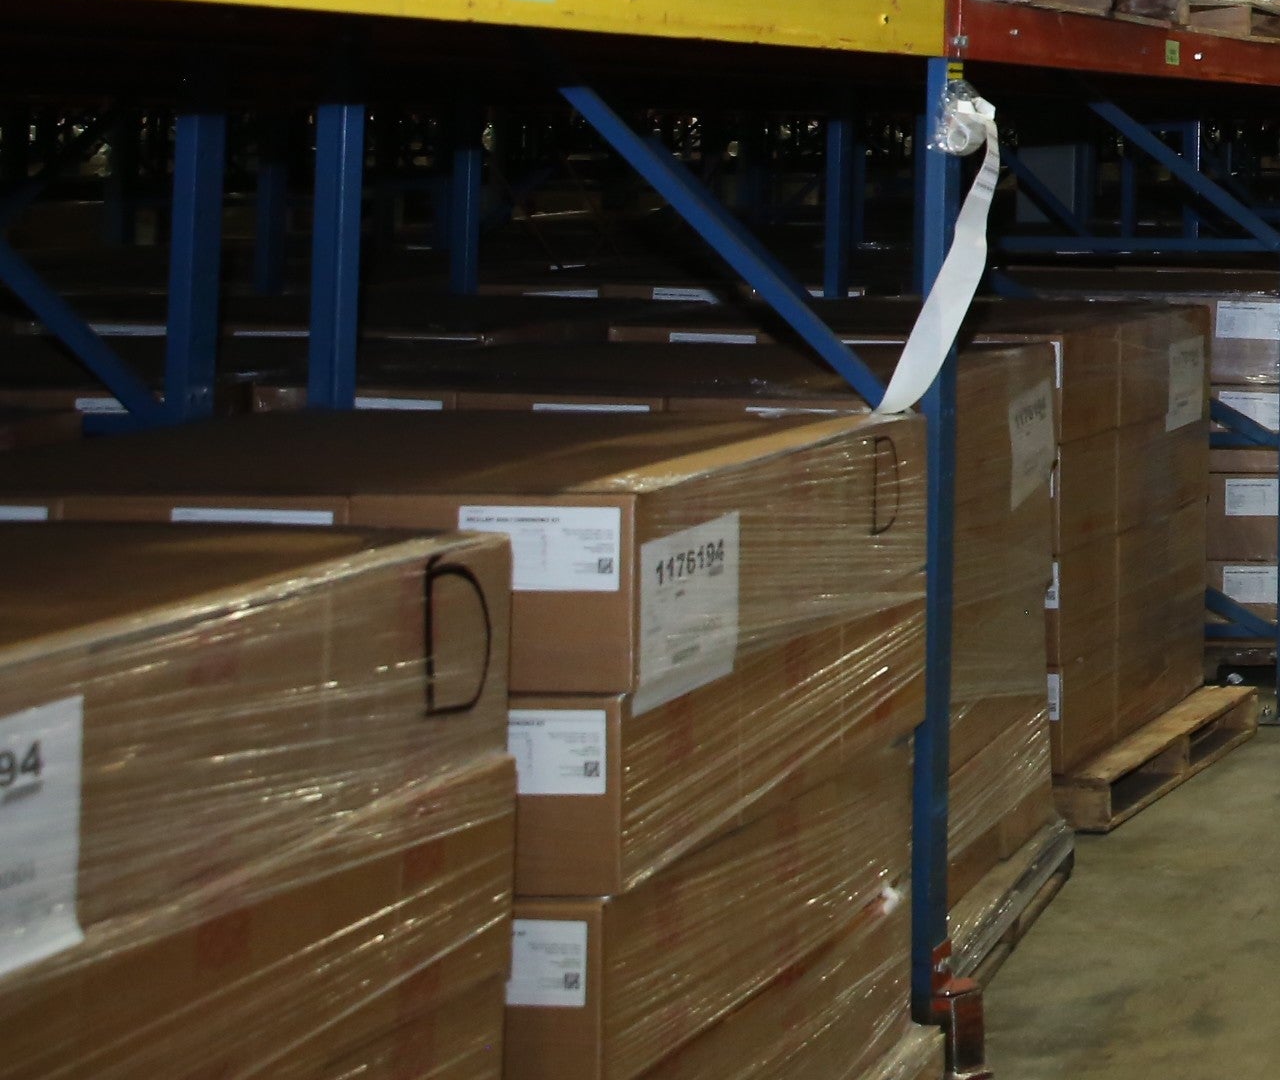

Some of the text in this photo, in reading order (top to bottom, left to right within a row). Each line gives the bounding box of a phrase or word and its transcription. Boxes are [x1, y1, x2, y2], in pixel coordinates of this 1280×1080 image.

[870, 435, 902, 537] D
[656, 538, 725, 586] 1176194
[423, 555, 492, 718] D
